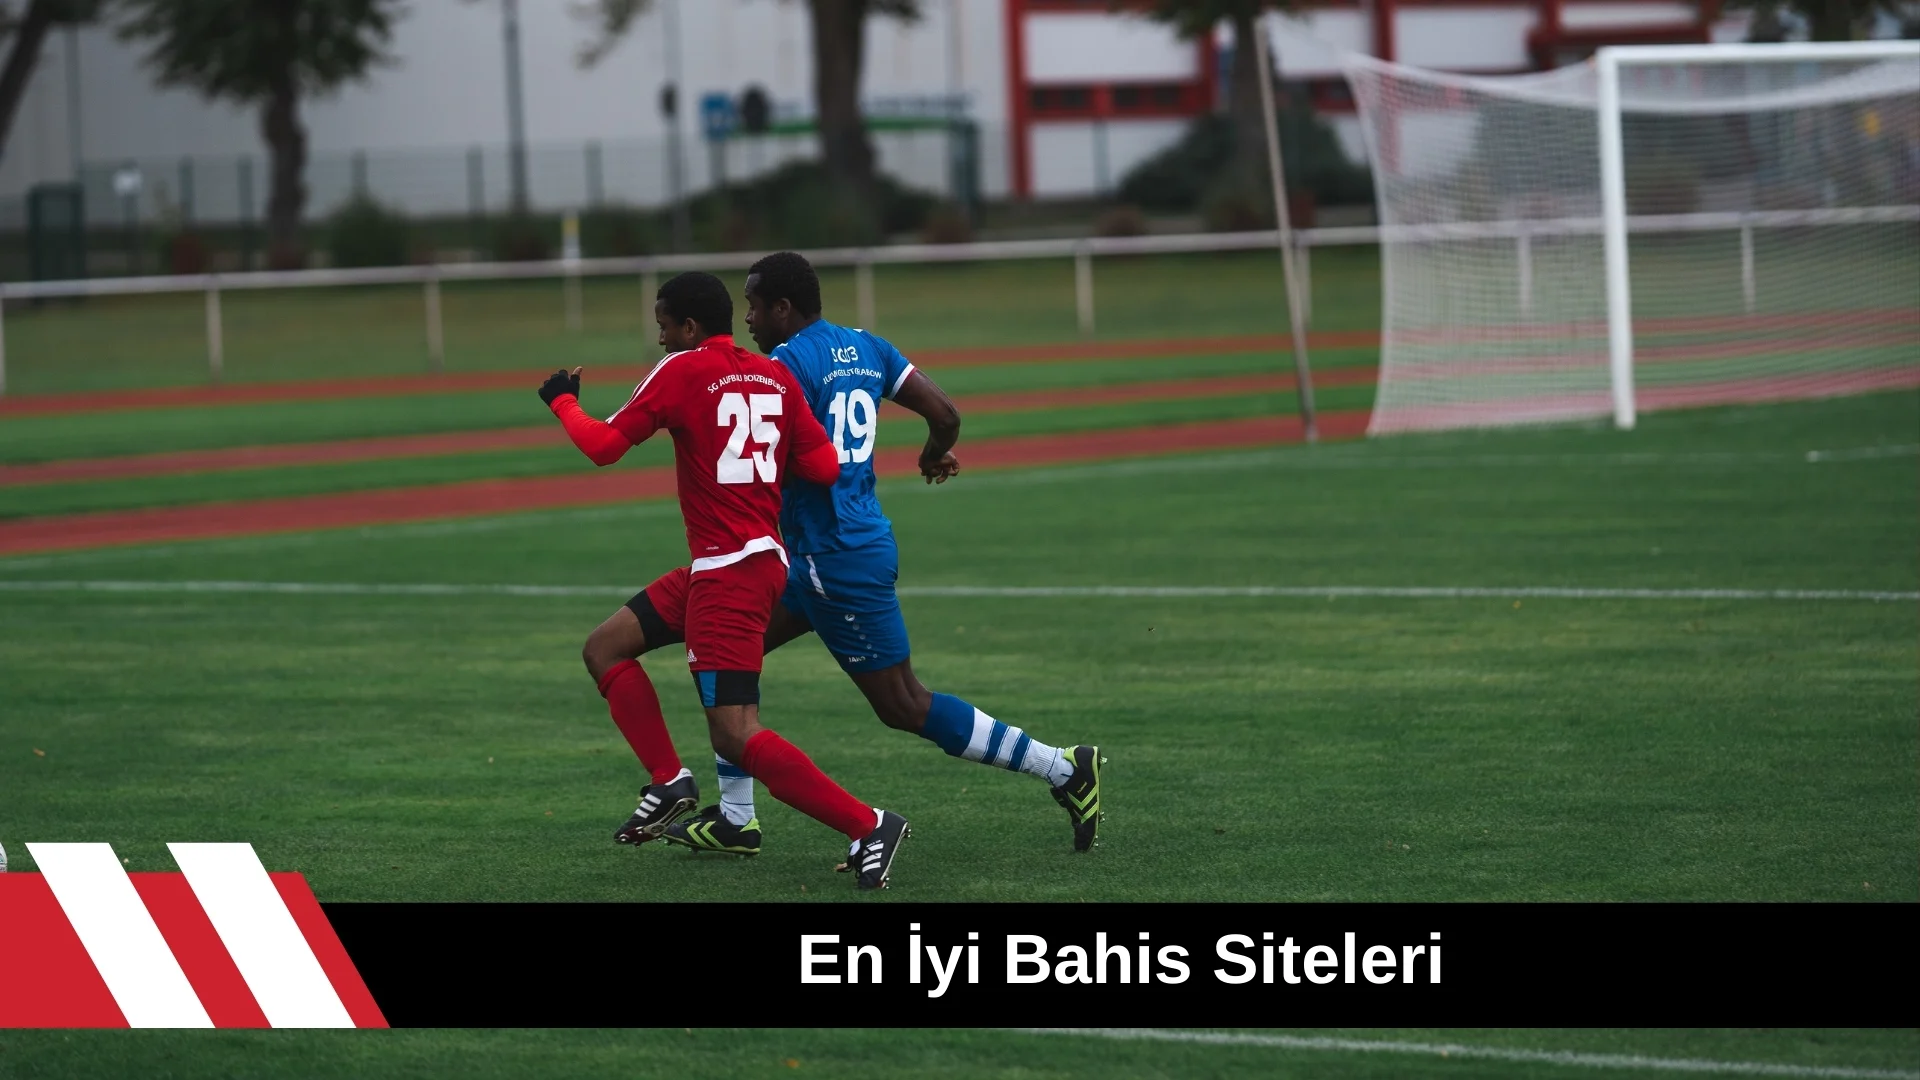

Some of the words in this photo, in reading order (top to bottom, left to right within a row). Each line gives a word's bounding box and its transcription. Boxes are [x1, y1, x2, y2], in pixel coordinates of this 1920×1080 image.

[707, 382, 719, 394] SG
[829, 388, 877, 464] 19
[717, 392, 783, 484] 25
